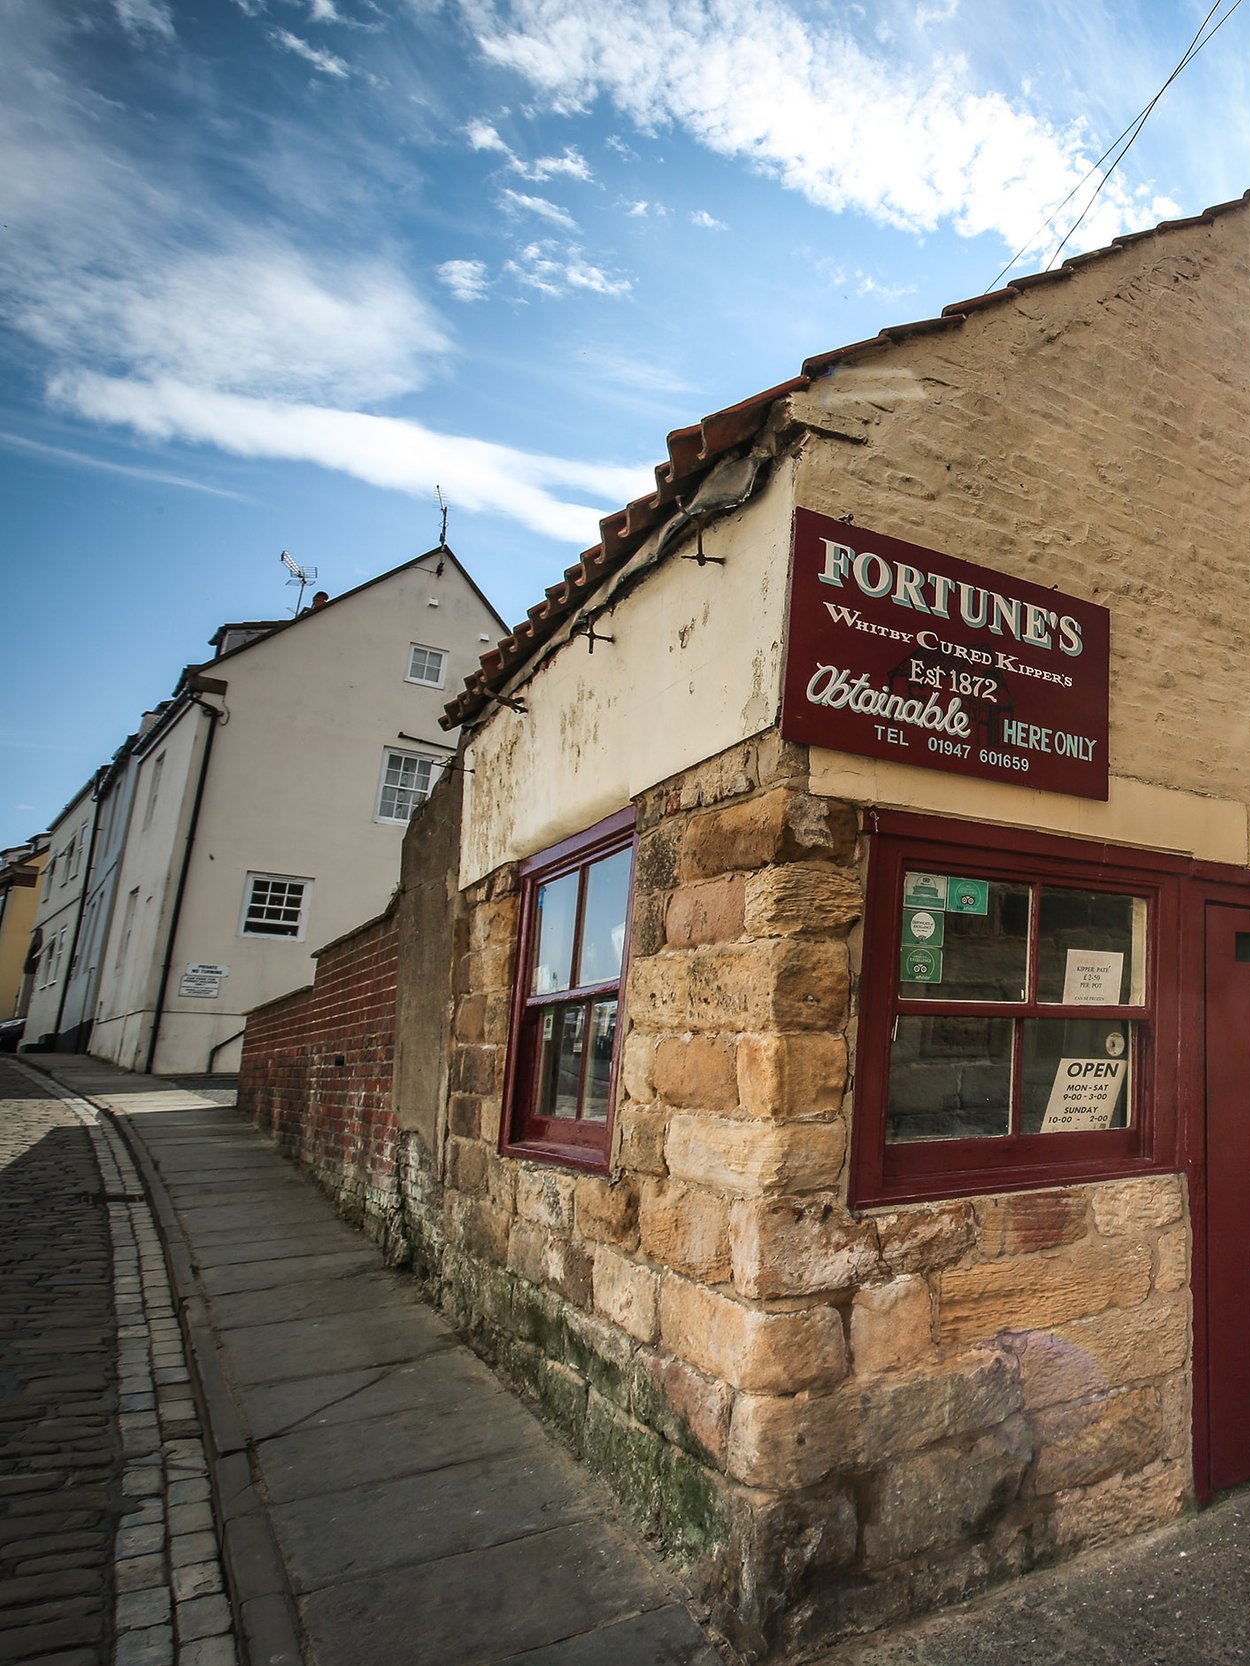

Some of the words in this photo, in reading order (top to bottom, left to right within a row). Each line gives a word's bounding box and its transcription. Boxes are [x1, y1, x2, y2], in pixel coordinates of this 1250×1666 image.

[818, 537, 1083, 657] FORTUNE'S
[916, 631, 992, 665] CURED
[909, 658, 945, 689] Est
[949, 669, 998, 703] 1872
[806, 662, 971, 739] Obtainable
[1003, 719, 1051, 753] HERE
[1055, 732, 1097, 762] ONLY
[874, 725, 909, 746] TEL
[928, 737, 971, 759] 01947
[979, 750, 1029, 771] 601659
[1067, 1062, 1119, 1078] OPEN
[1064, 1106, 1099, 1114] SUNDAY
